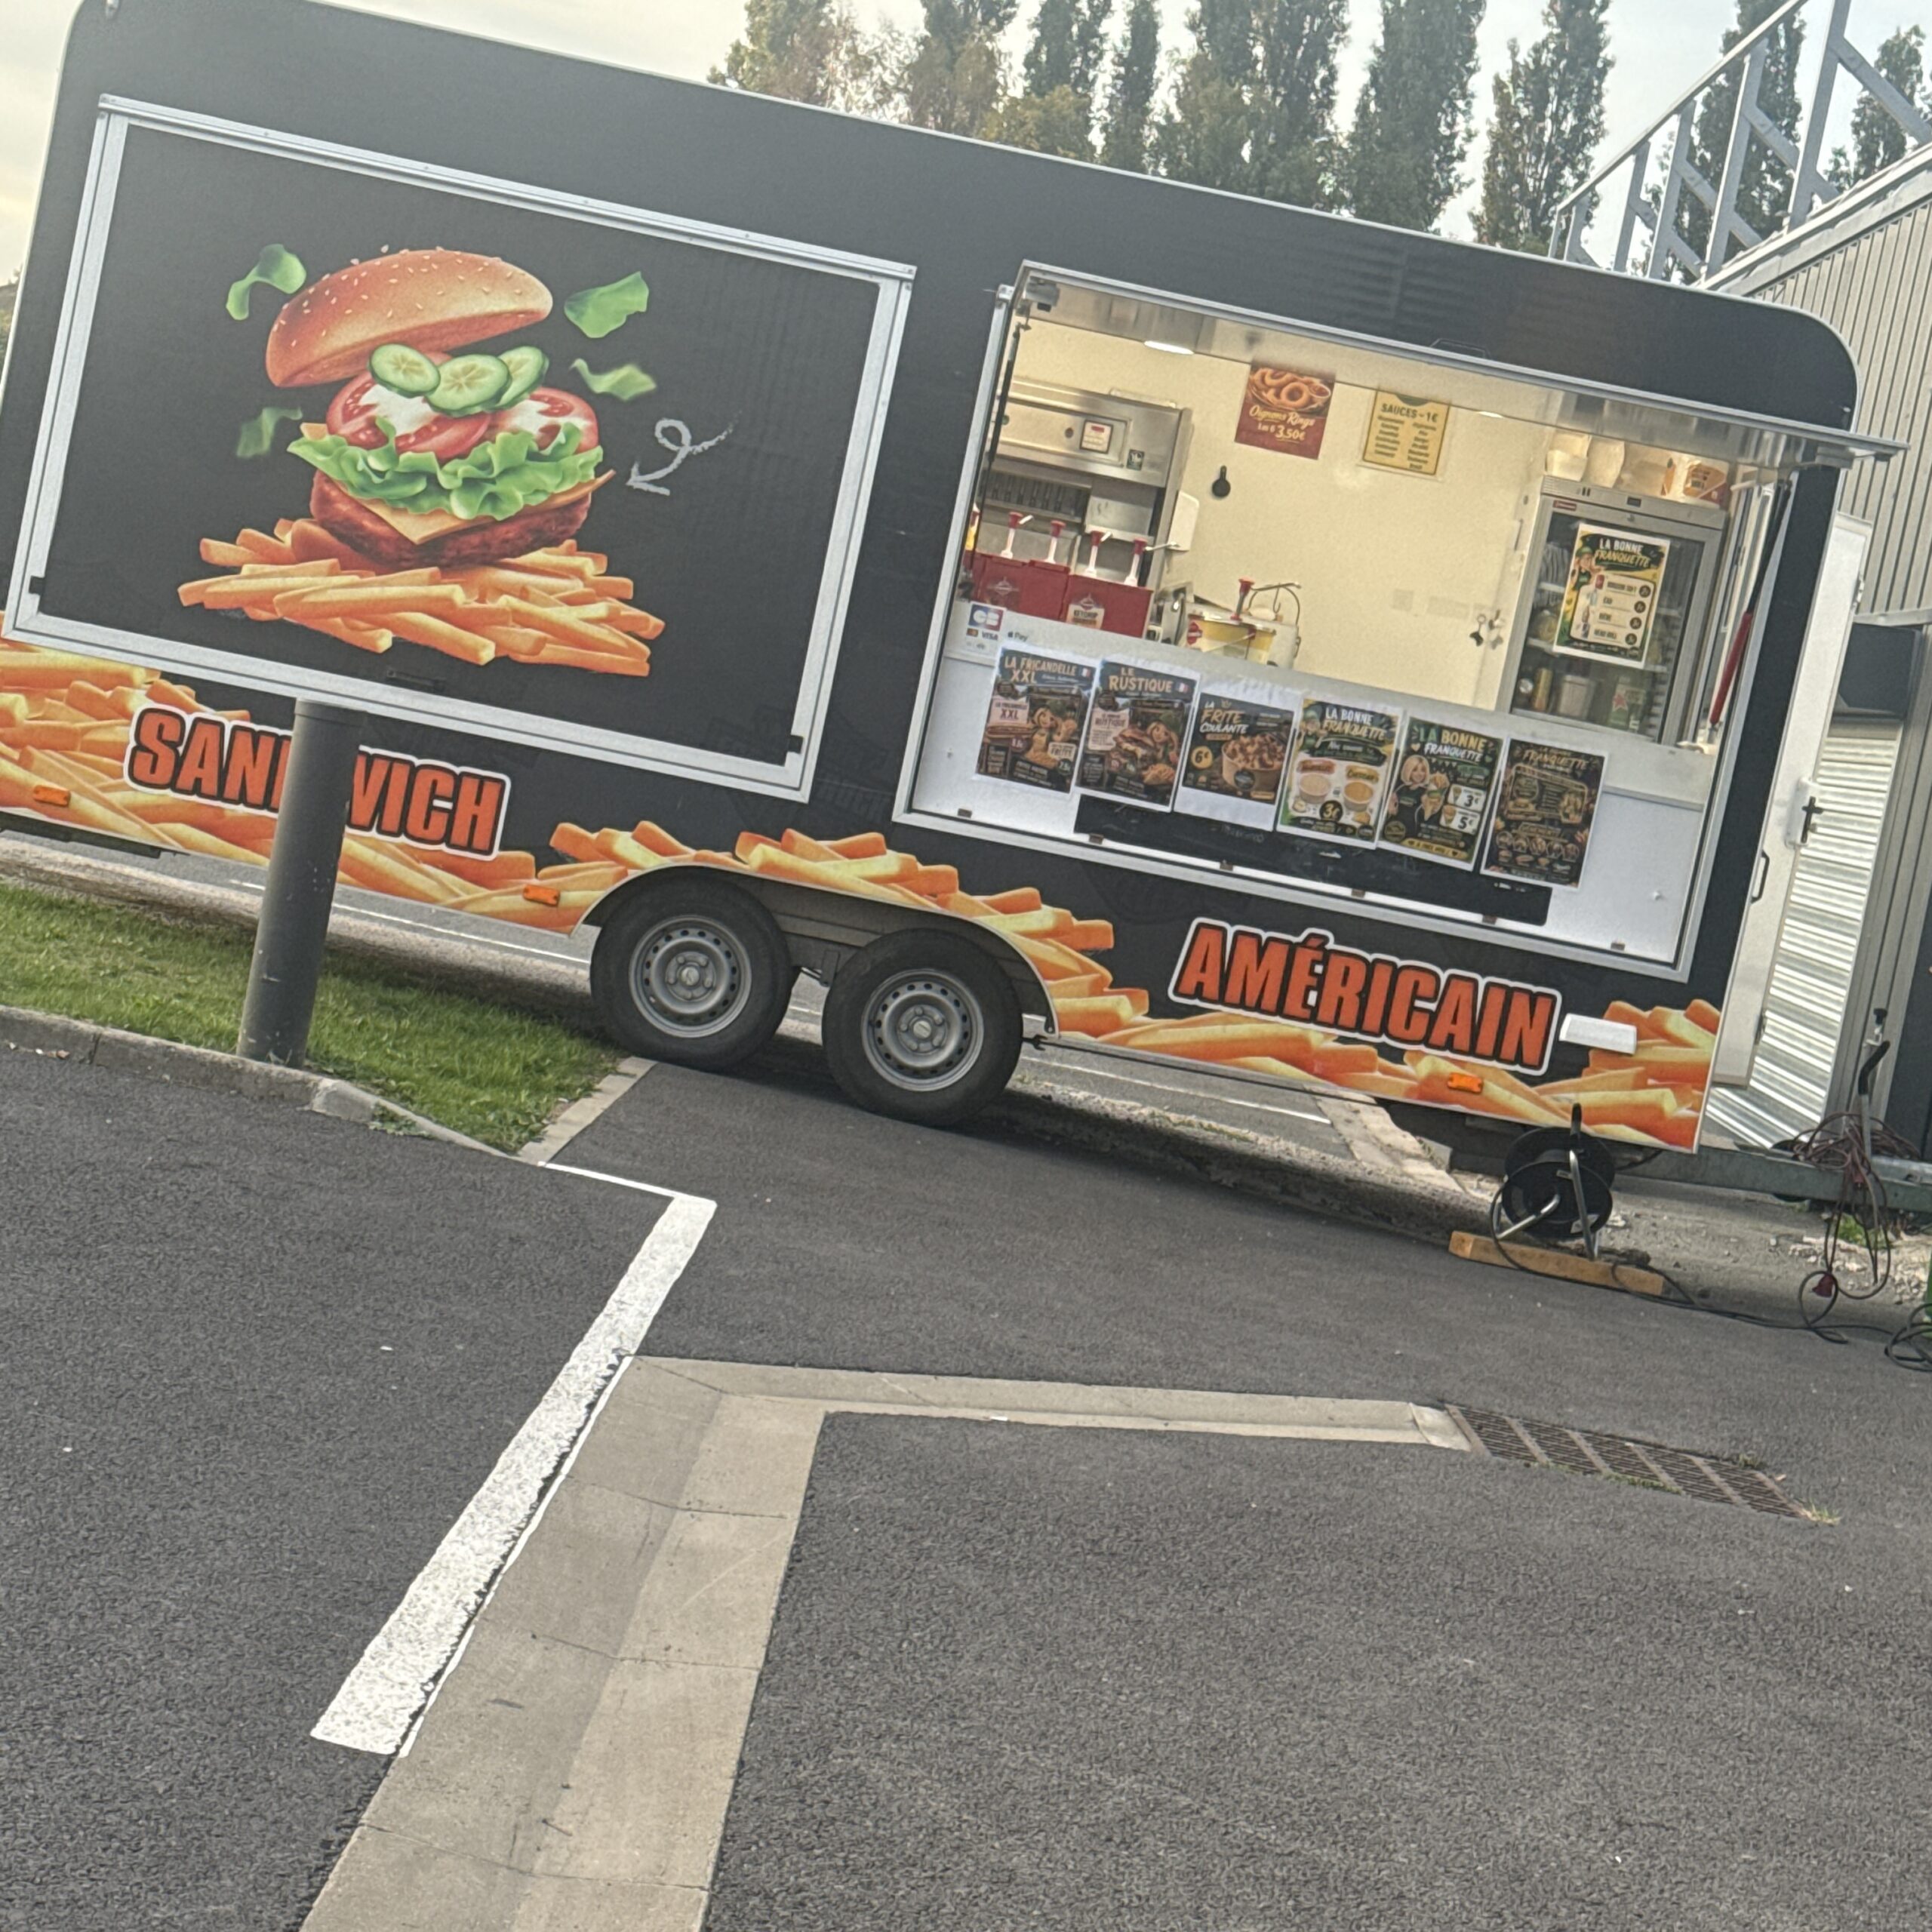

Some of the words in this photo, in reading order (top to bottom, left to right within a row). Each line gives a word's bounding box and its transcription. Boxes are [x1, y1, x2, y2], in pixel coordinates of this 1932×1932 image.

[1380, 403, 1417, 419] SAUCES
[1599, 538, 1611, 550] LA
[1614, 540, 1644, 553] BONNE
[1593, 549, 1651, 568] FRANQUETTE
[982, 631, 998, 641] VISA
[1004, 656, 1017, 669] LA
[1020, 657, 1078, 676] FRICANDELLE
[1121, 667, 1135, 677] LE
[1011, 669, 1037, 684] XXL
[1109, 675, 1174, 692] RUSTIQUE
[1001, 708, 1019, 721] XXL
[1200, 709, 1245, 724] FRITE
[1325, 706, 1338, 719] LA
[1341, 708, 1374, 726] BONNE
[1199, 722, 1249, 734] COULANTE
[1322, 719, 1388, 741] FRANQUETTE
[1419, 727, 1438, 743] LA
[1441, 729, 1488, 752] BONNE
[1424, 742, 1484, 762] FRANQUETTE
[1171, 919, 1560, 1072] AMÉRICAIN
